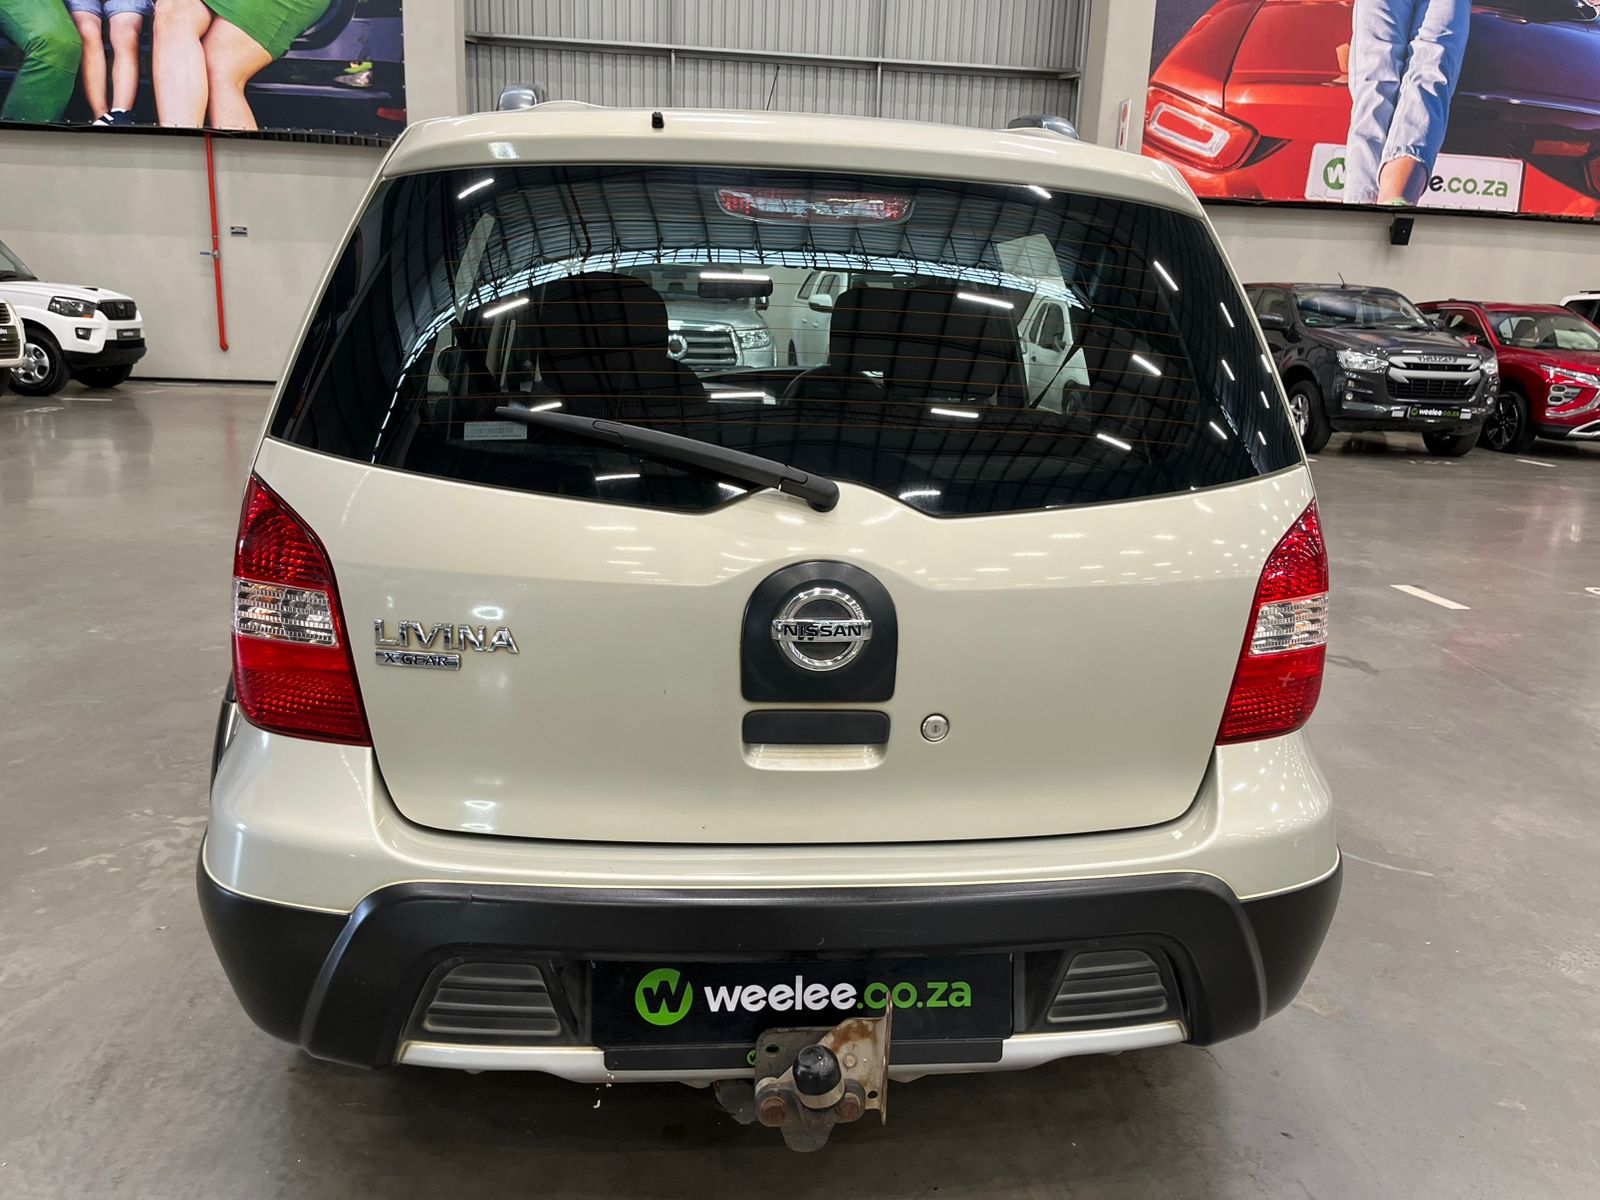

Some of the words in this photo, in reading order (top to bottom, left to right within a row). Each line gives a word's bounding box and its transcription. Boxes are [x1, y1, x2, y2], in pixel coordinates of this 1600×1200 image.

[1429, 175, 1509, 198] e.co.za
[374, 618, 520, 655] LIVINA
[783, 624, 862, 637] NISSAN
[704, 974, 972, 1013] weelee.co.za
